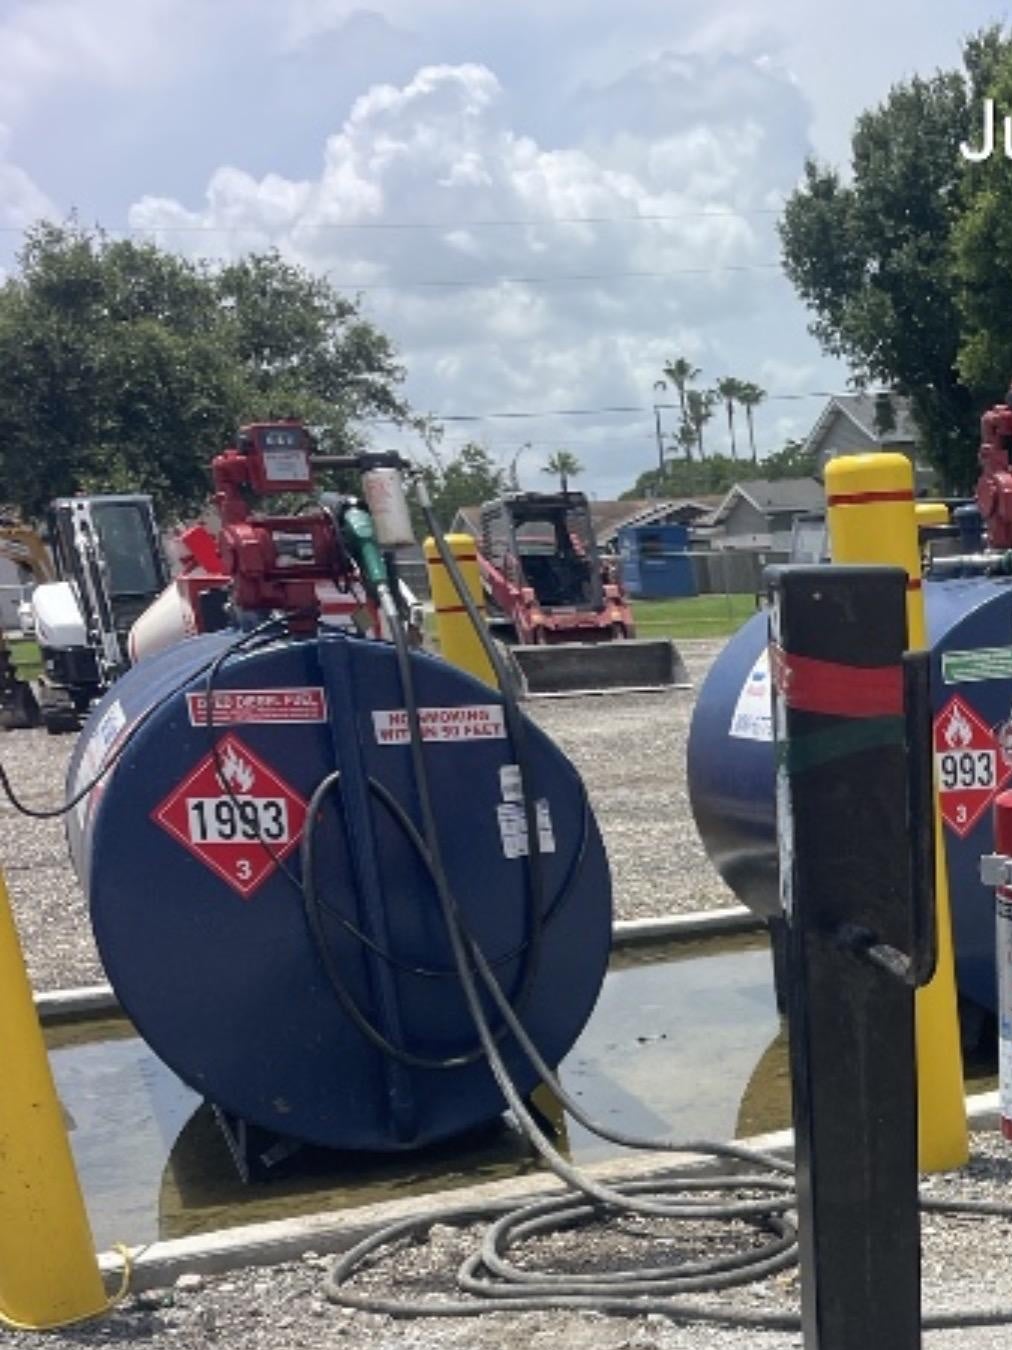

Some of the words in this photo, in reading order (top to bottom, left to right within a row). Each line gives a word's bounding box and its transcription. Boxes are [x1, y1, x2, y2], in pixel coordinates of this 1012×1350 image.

[380, 725, 437, 741] WITIN
[941, 752, 993, 788] 993
[192, 801, 286, 842] 1993
[956, 804, 968, 823] 3
[235, 859, 253, 880] 3
